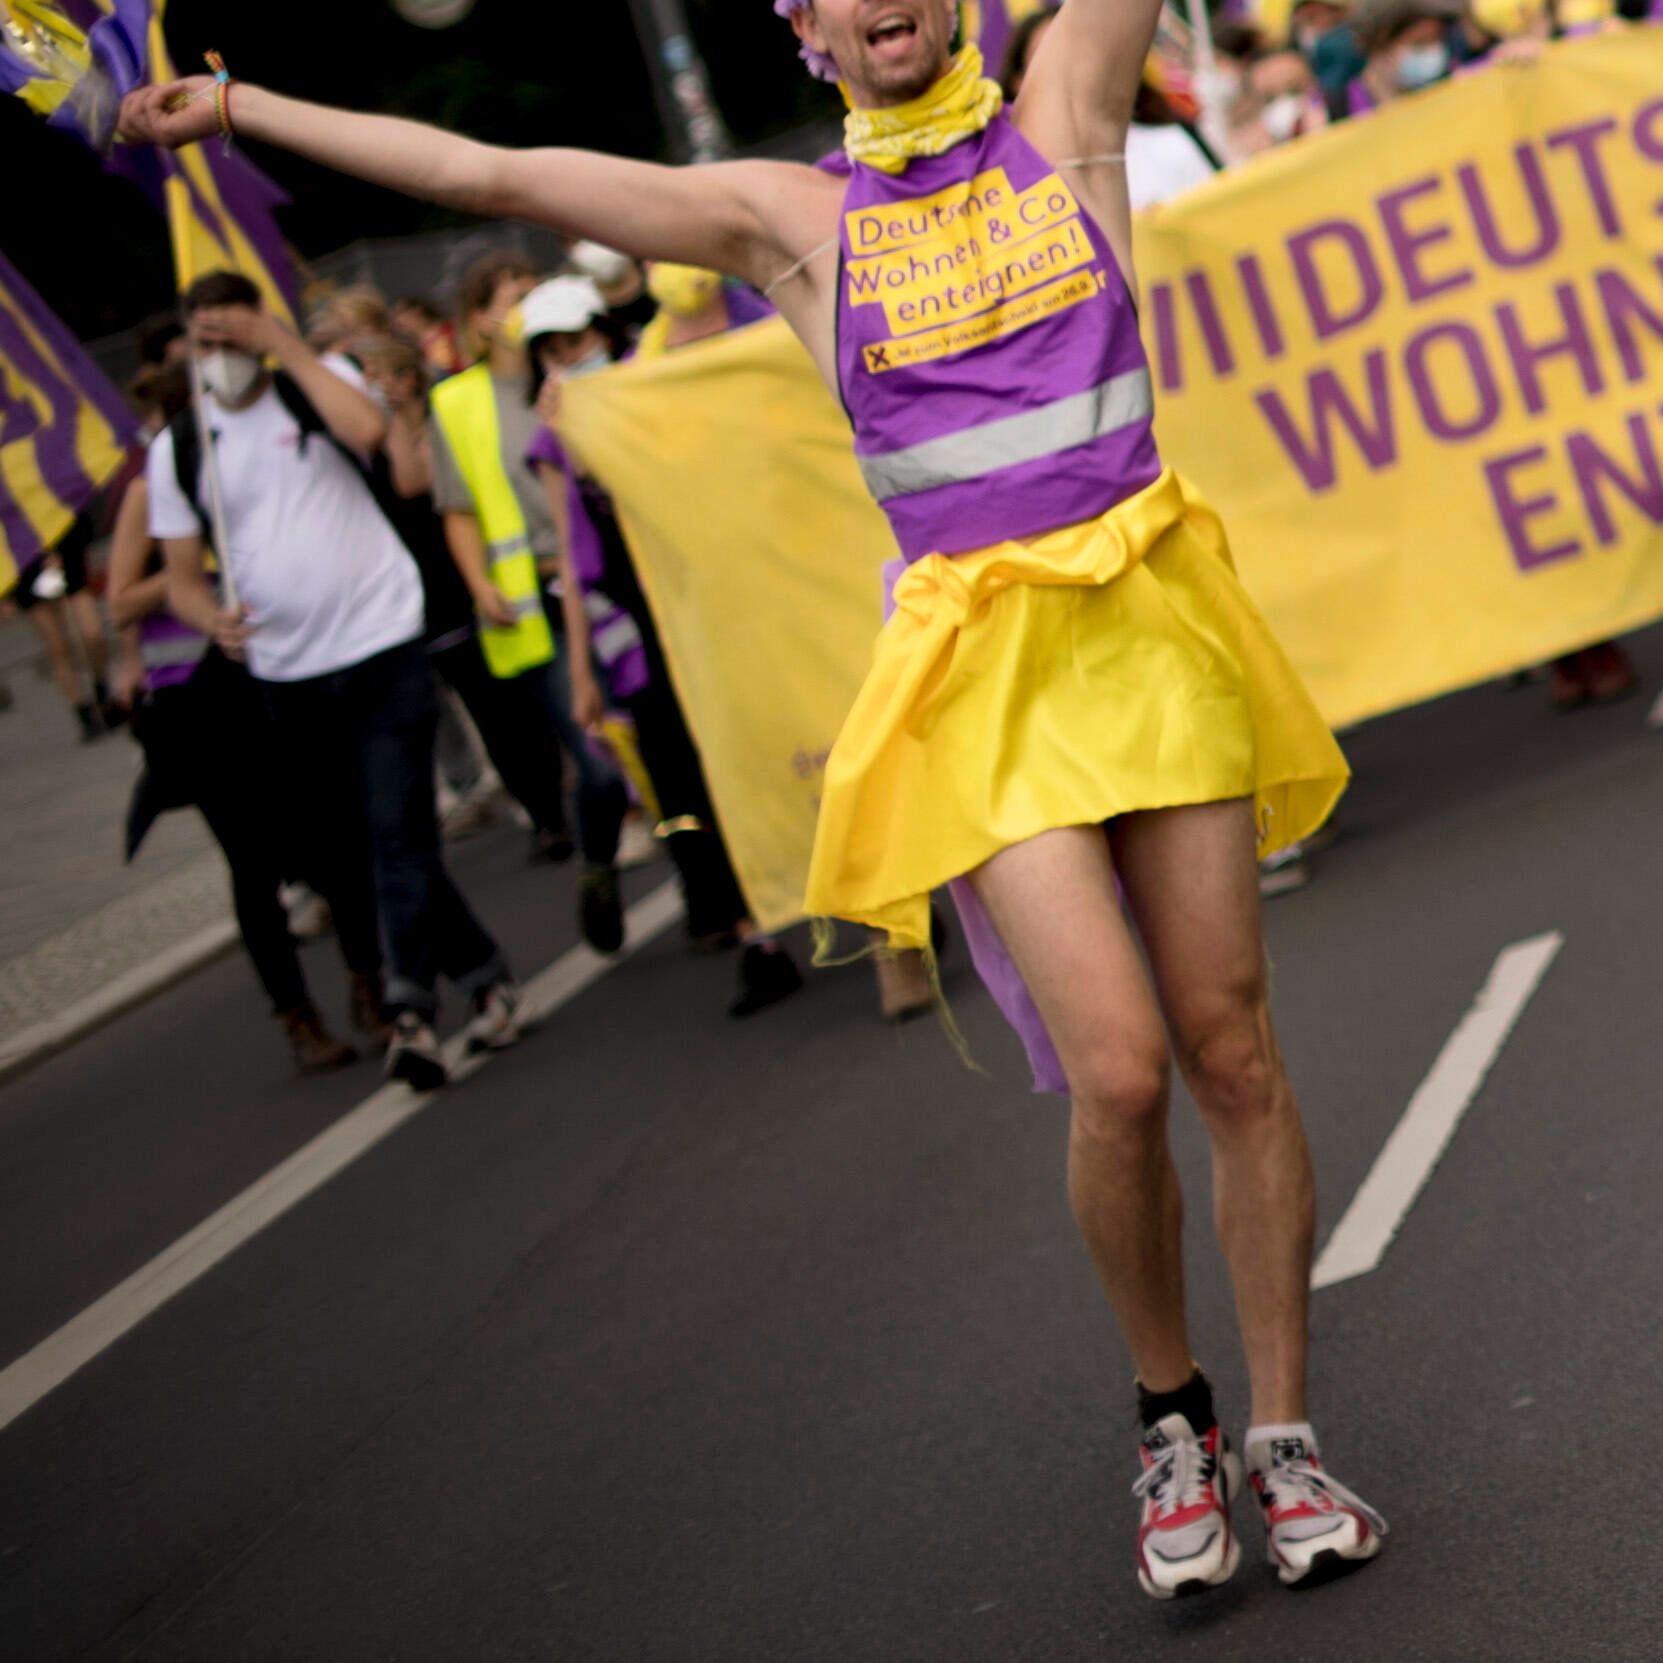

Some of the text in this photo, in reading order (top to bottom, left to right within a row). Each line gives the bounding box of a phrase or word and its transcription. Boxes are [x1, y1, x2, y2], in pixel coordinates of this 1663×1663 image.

[848, 193, 1067, 296] Wohnen & Co
[896, 226, 1081, 322] enteignen!
